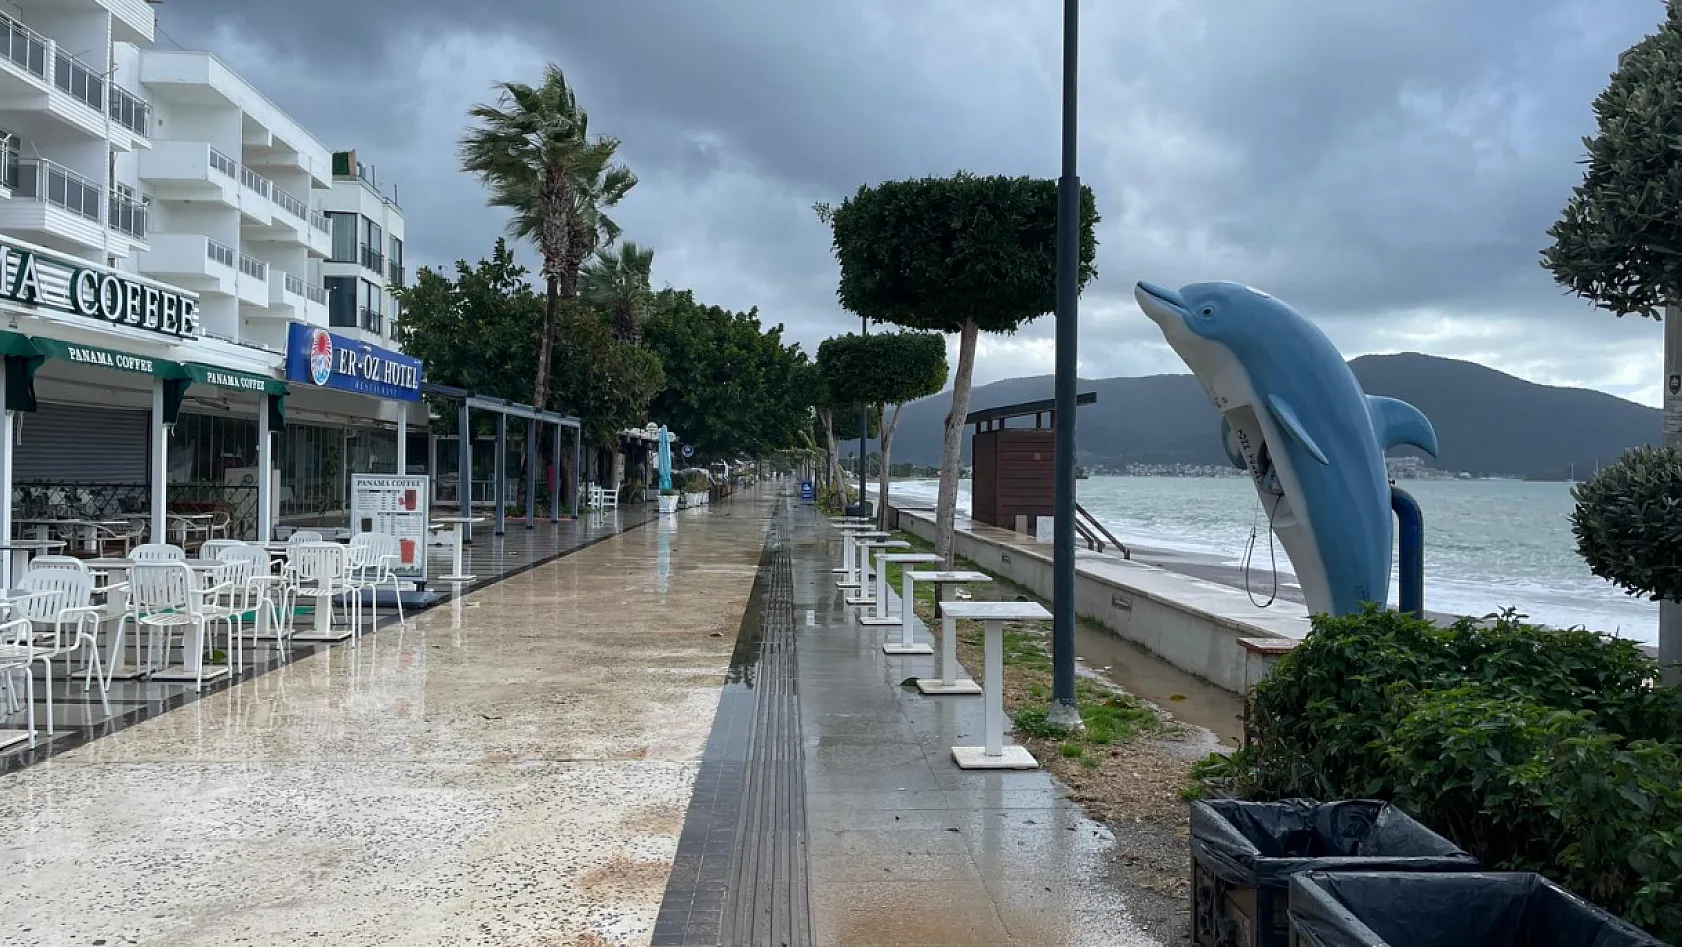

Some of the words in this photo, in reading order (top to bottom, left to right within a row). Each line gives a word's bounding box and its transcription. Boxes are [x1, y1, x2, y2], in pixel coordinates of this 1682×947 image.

[72, 268, 197, 337] COFFEE
[68, 347, 114, 367] PANAMA
[116, 354, 153, 372] COFFEE
[206, 372, 239, 387] PANAMA
[240, 377, 265, 390] COFFEE
[385, 359, 418, 389] HOTEL
